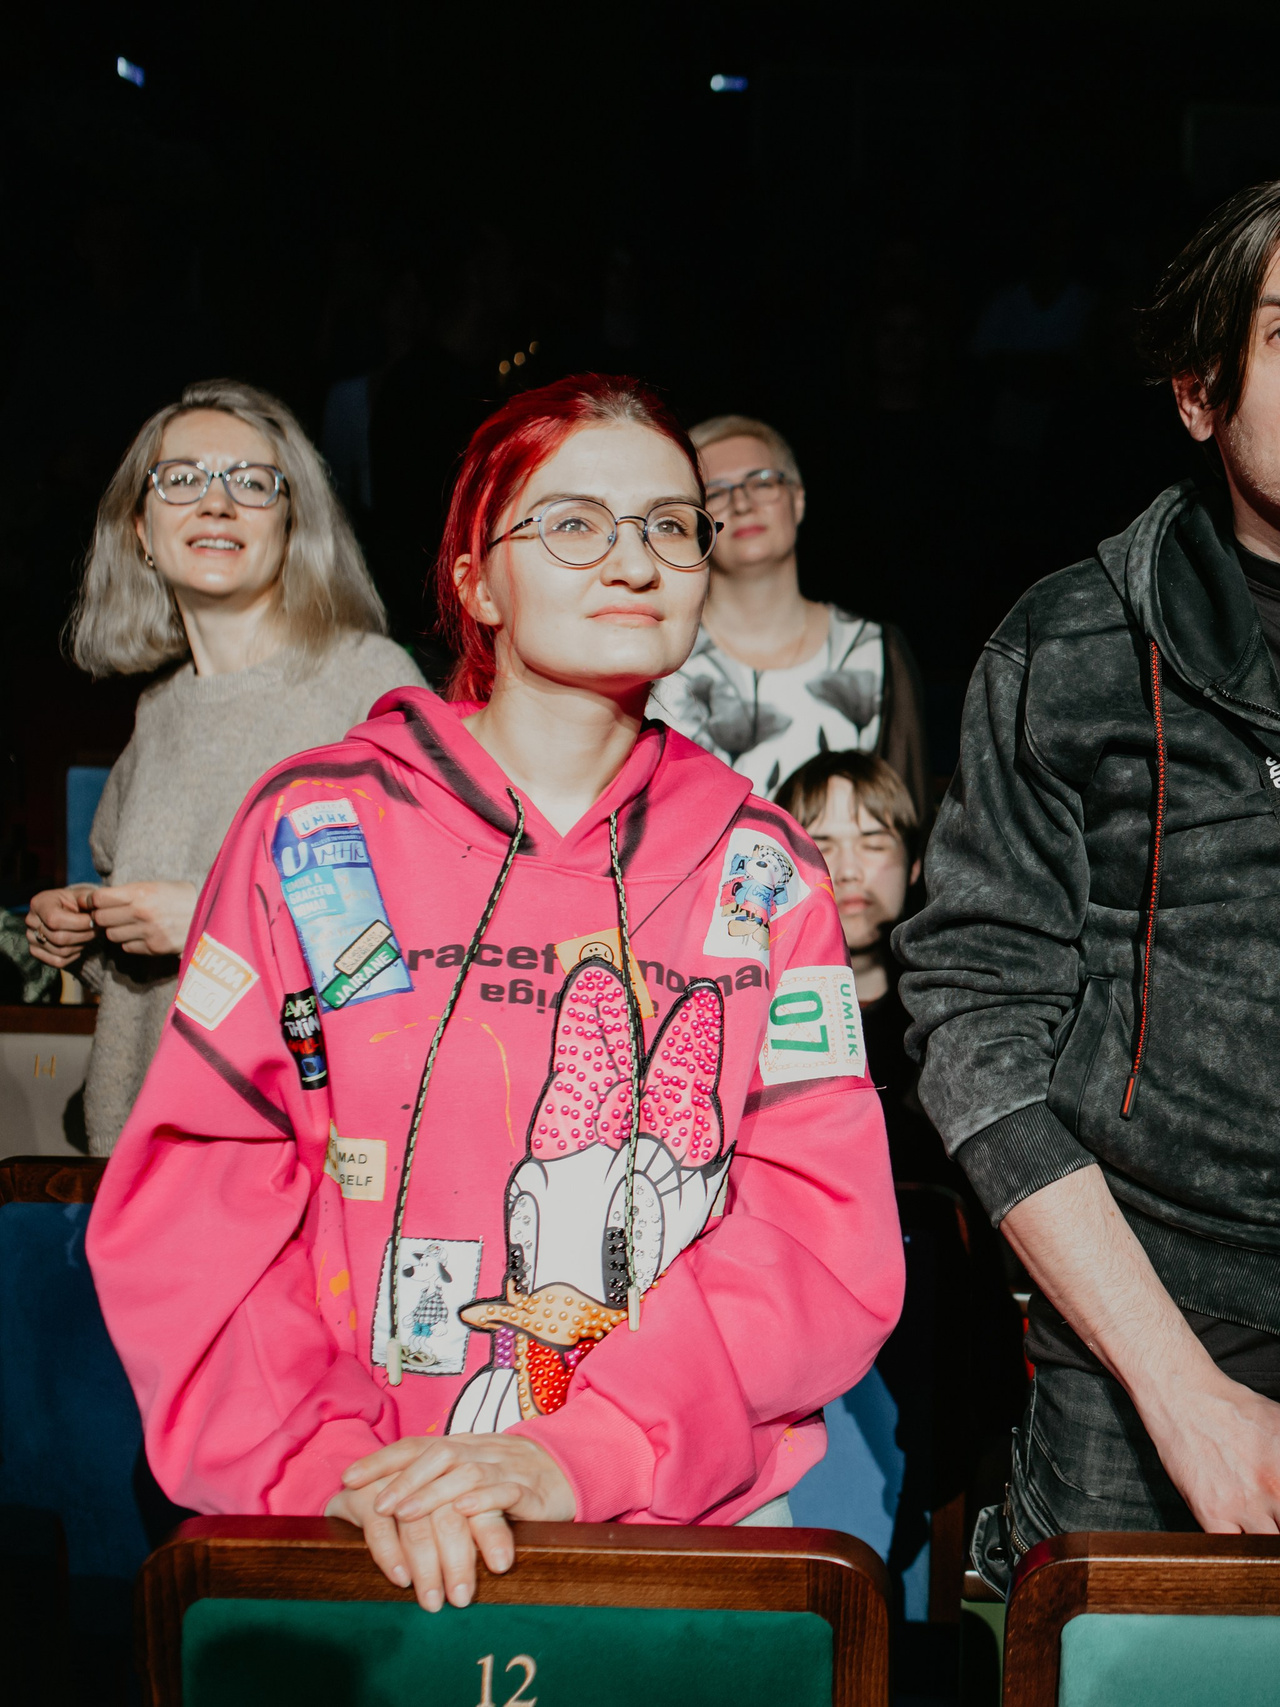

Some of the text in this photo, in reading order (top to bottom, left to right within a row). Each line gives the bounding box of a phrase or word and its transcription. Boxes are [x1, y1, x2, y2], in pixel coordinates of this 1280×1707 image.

[302, 813, 348, 831] UMHK
[336, 951, 393, 1005] JAIRANE
[769, 990, 829, 1053] 07
[840, 983, 859, 1057] UMHK
[339, 1152, 368, 1164] MAD
[340, 1173, 373, 1186] SELF
[476, 1653, 538, 1707] 12
